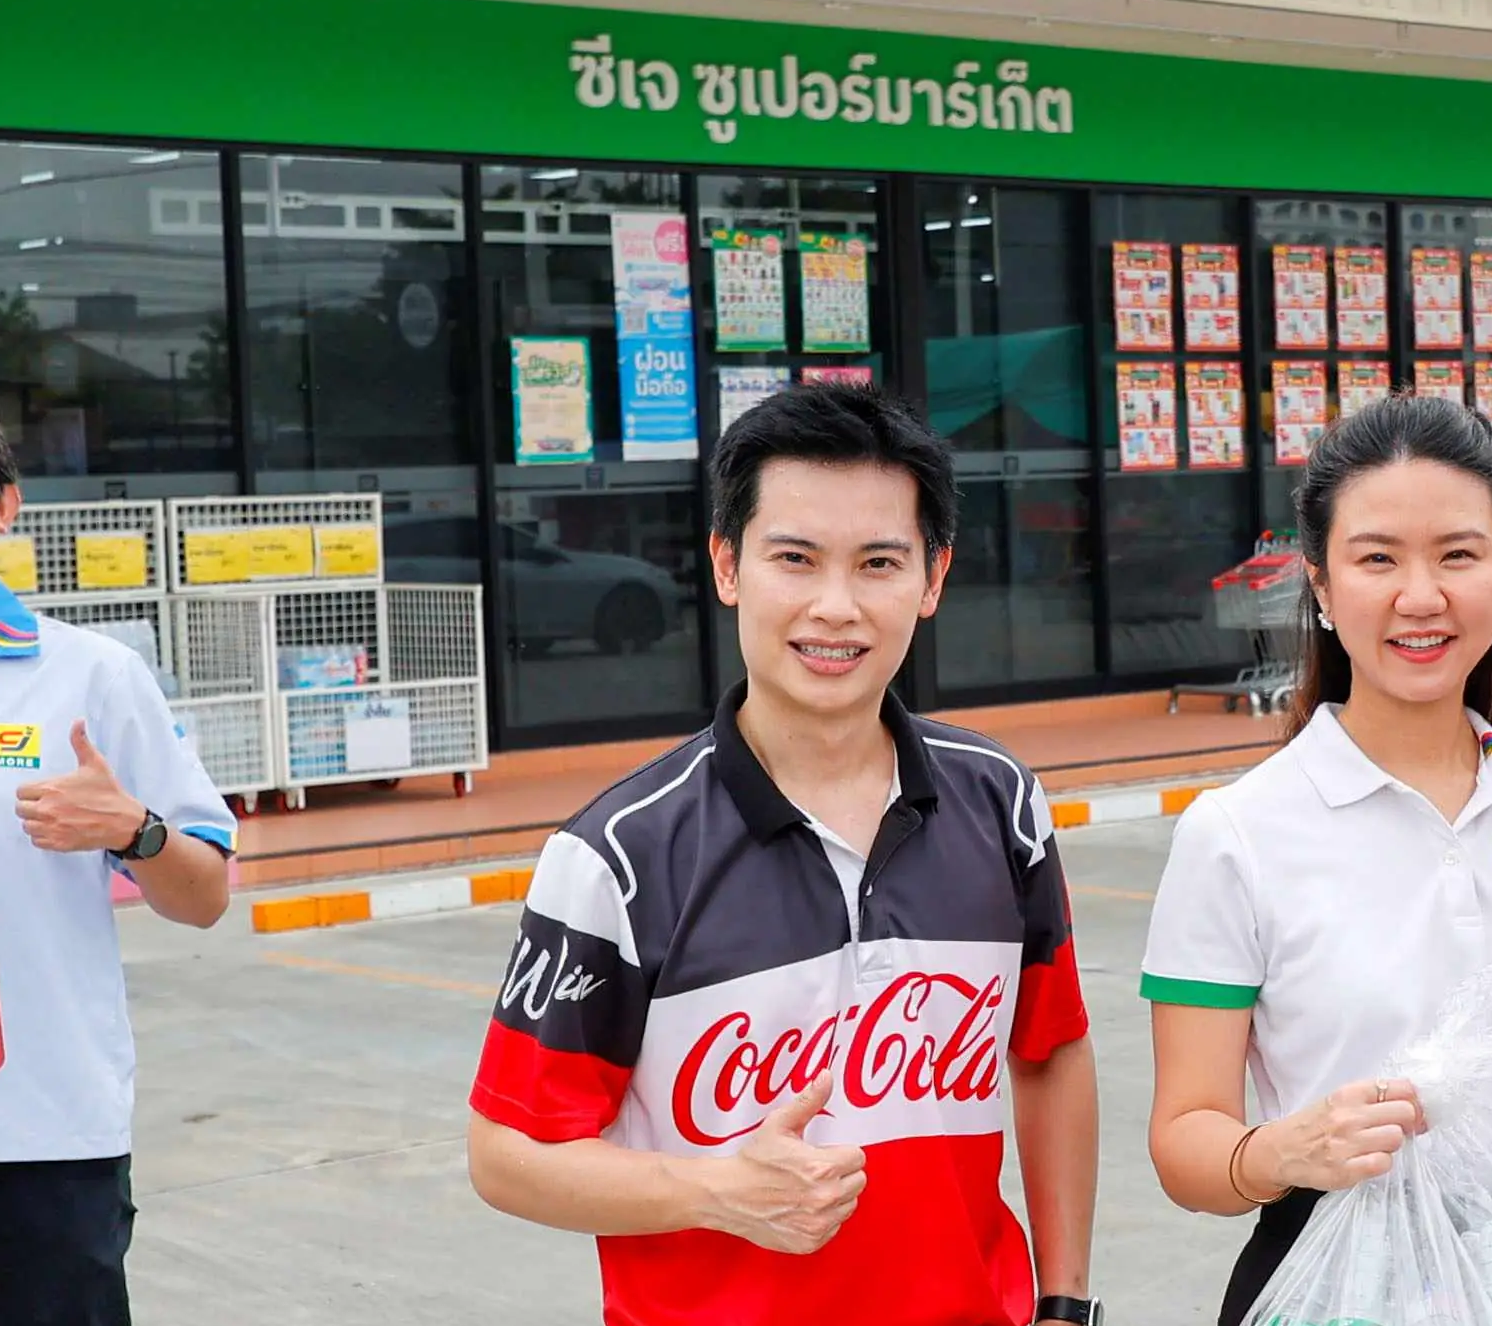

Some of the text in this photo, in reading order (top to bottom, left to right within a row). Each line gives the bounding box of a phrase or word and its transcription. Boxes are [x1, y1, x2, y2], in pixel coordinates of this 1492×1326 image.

[569, 35, 1074, 144] ซีเจ ซูเปอร์มาร์เก็ต
[672, 971, 1009, 1147] Coca-Cola
